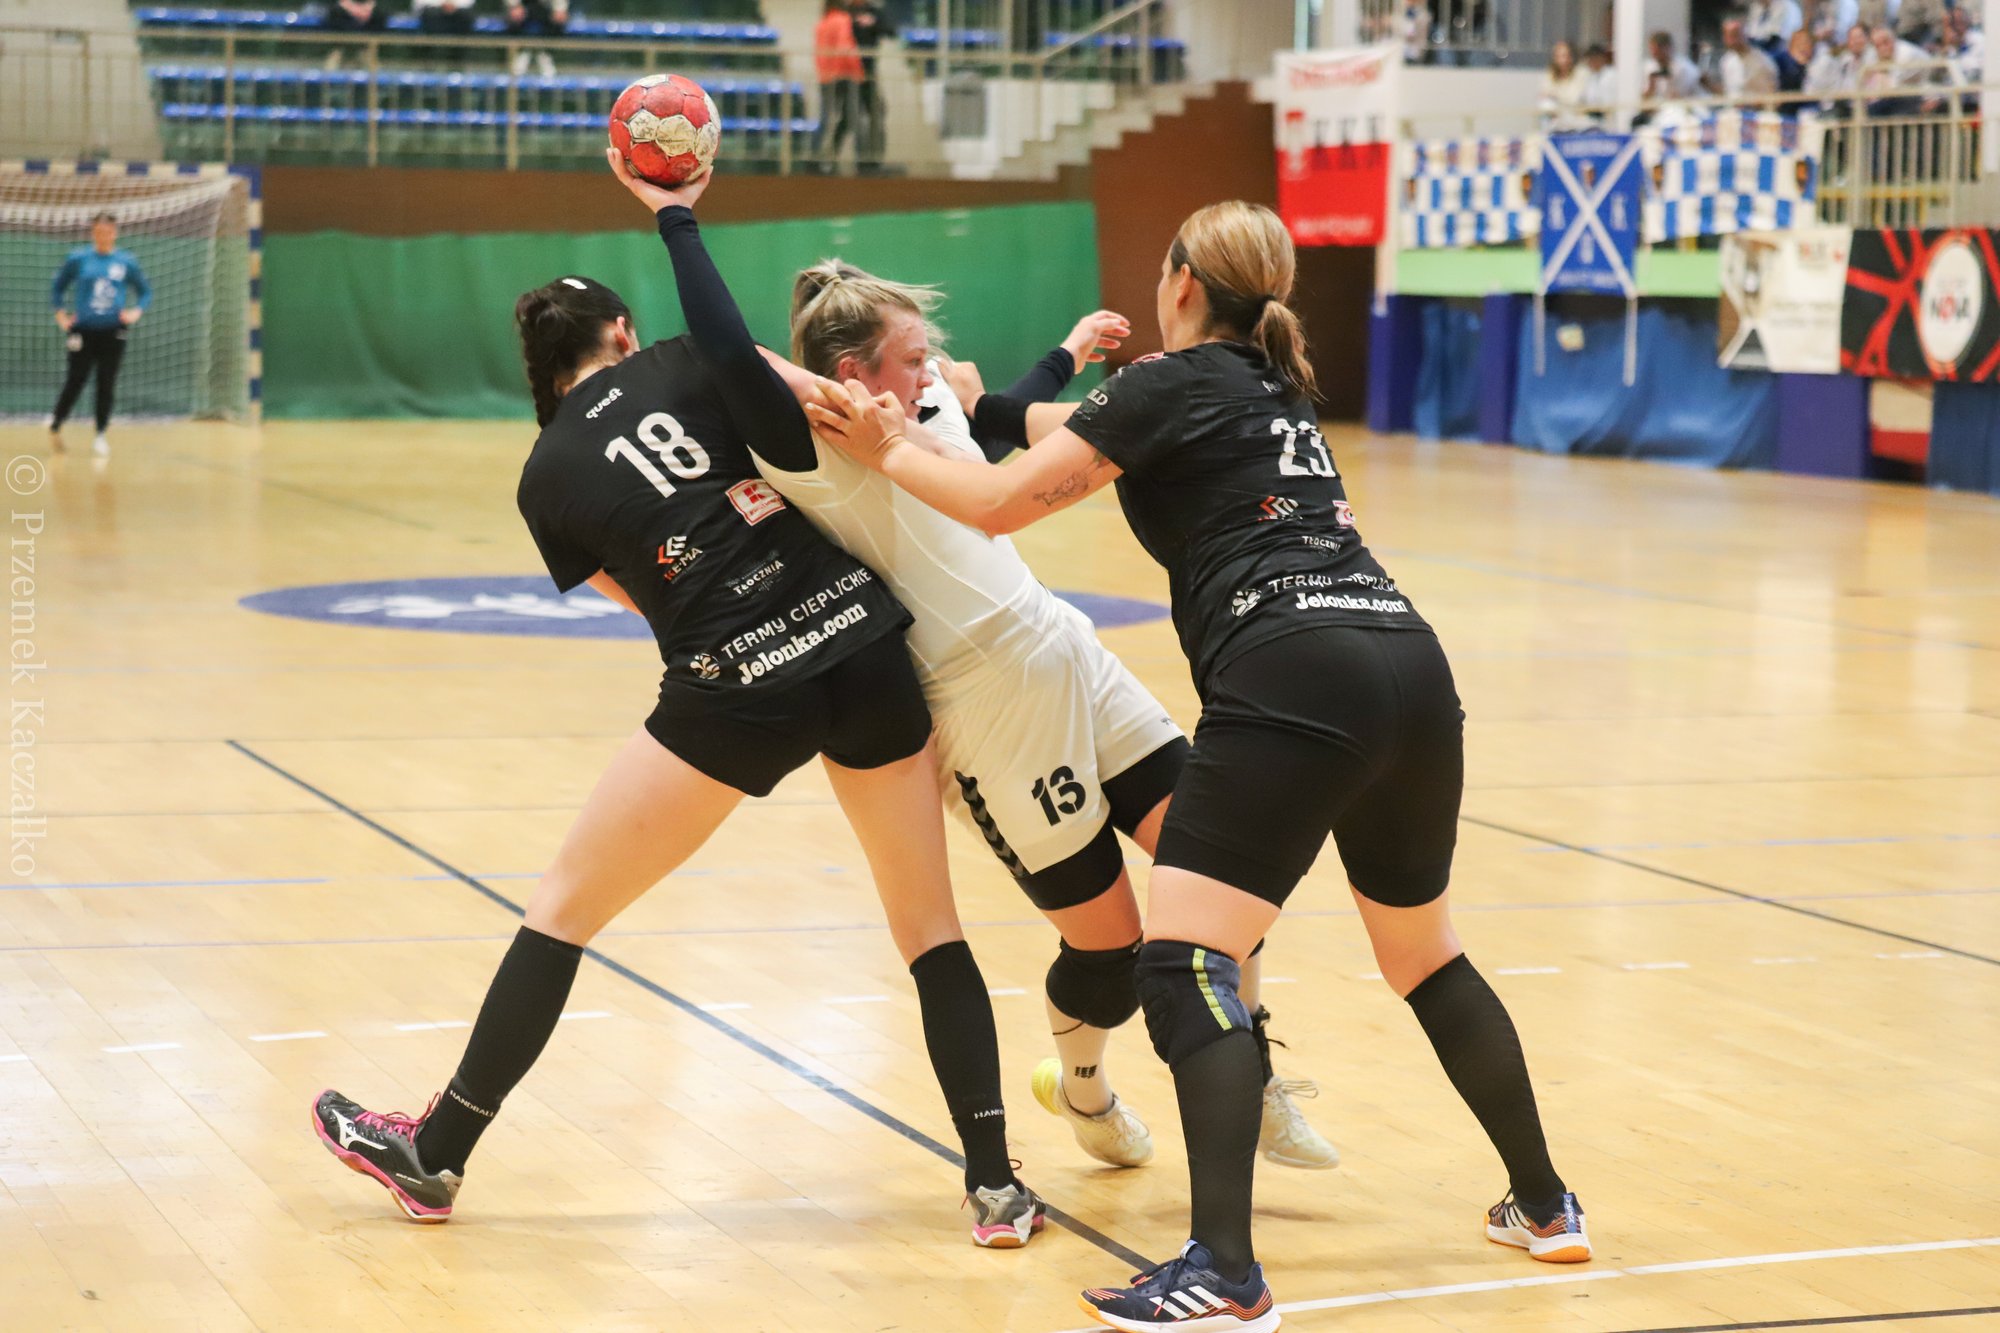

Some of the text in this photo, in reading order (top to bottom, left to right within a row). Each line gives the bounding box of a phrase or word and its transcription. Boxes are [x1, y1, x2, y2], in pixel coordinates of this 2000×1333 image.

[586, 388, 623, 419] quest
[604, 411, 711, 499] 18
[1270, 418, 1336, 478] 23
[733, 560, 784, 595] TŁOCZNIA
[1296, 592, 1409, 613] Jelonka.com
[721, 567, 872, 659] TERMY CIEPLICKIE
[738, 603, 868, 685] Jelonka.com
[1031, 765, 1087, 827] 13
